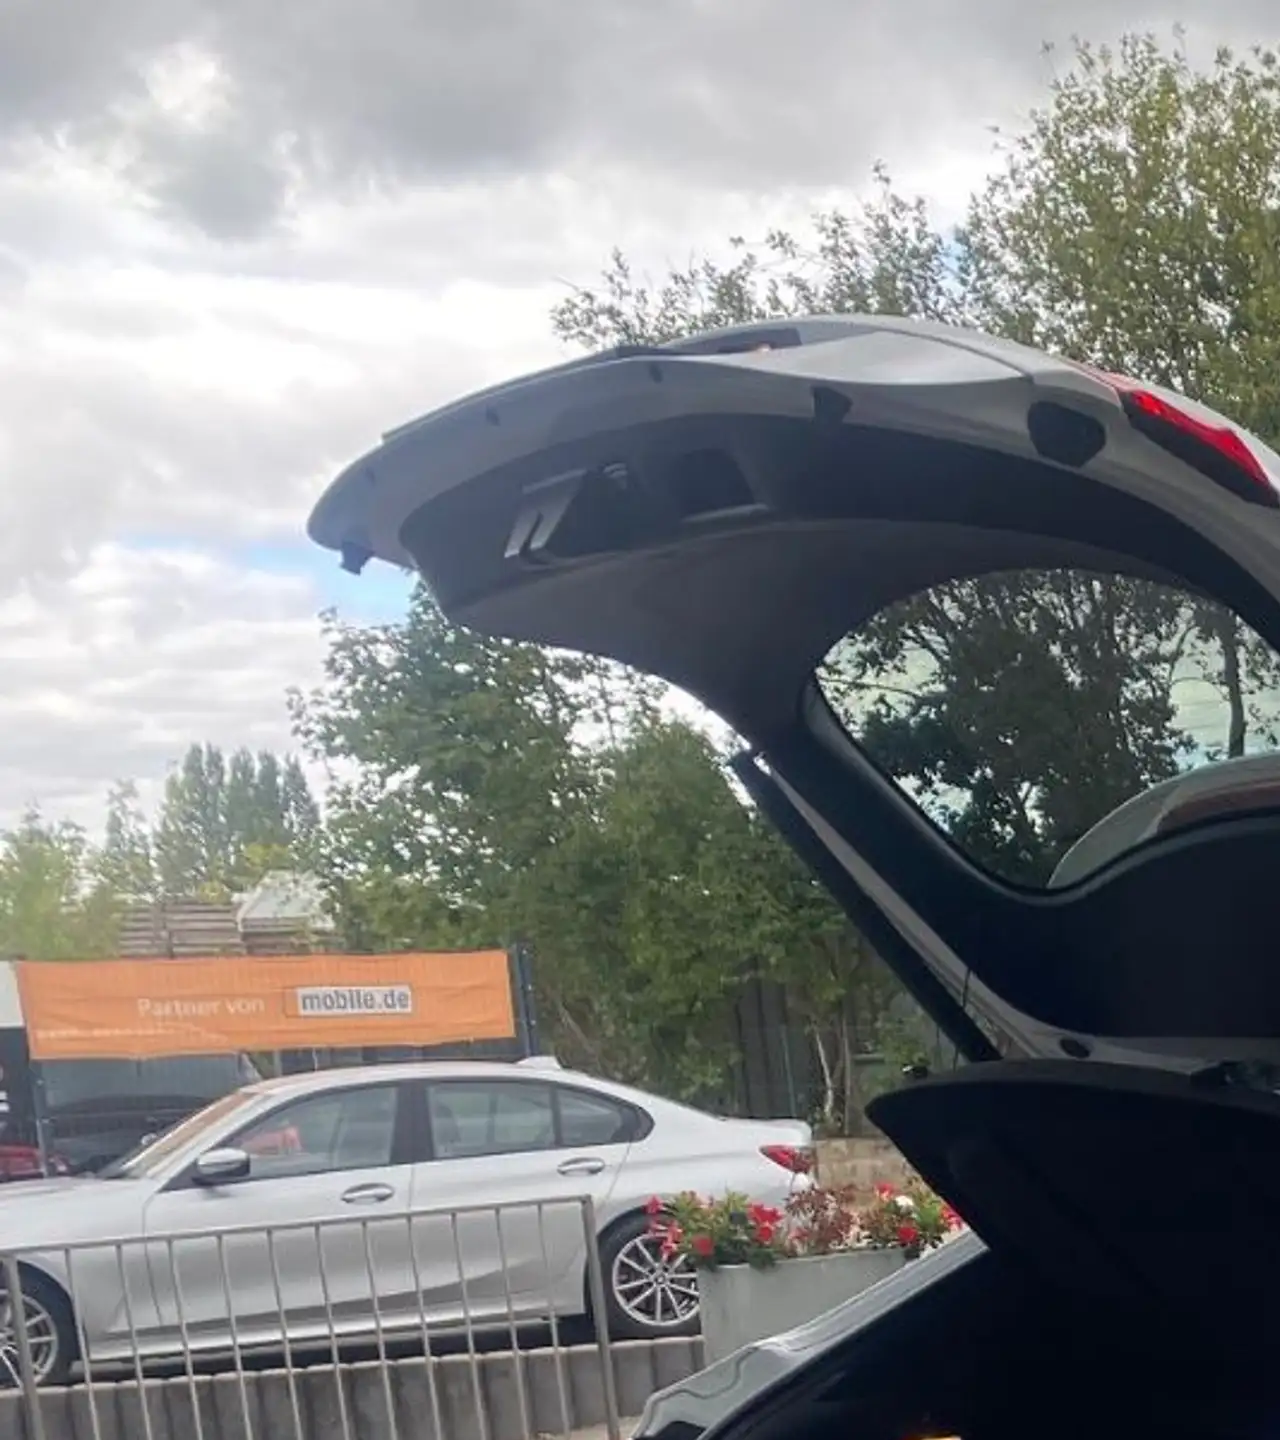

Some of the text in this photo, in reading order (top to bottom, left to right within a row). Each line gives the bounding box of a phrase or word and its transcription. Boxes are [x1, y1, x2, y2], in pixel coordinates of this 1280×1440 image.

[137, 988, 410, 1018] Partner von mobile.de
